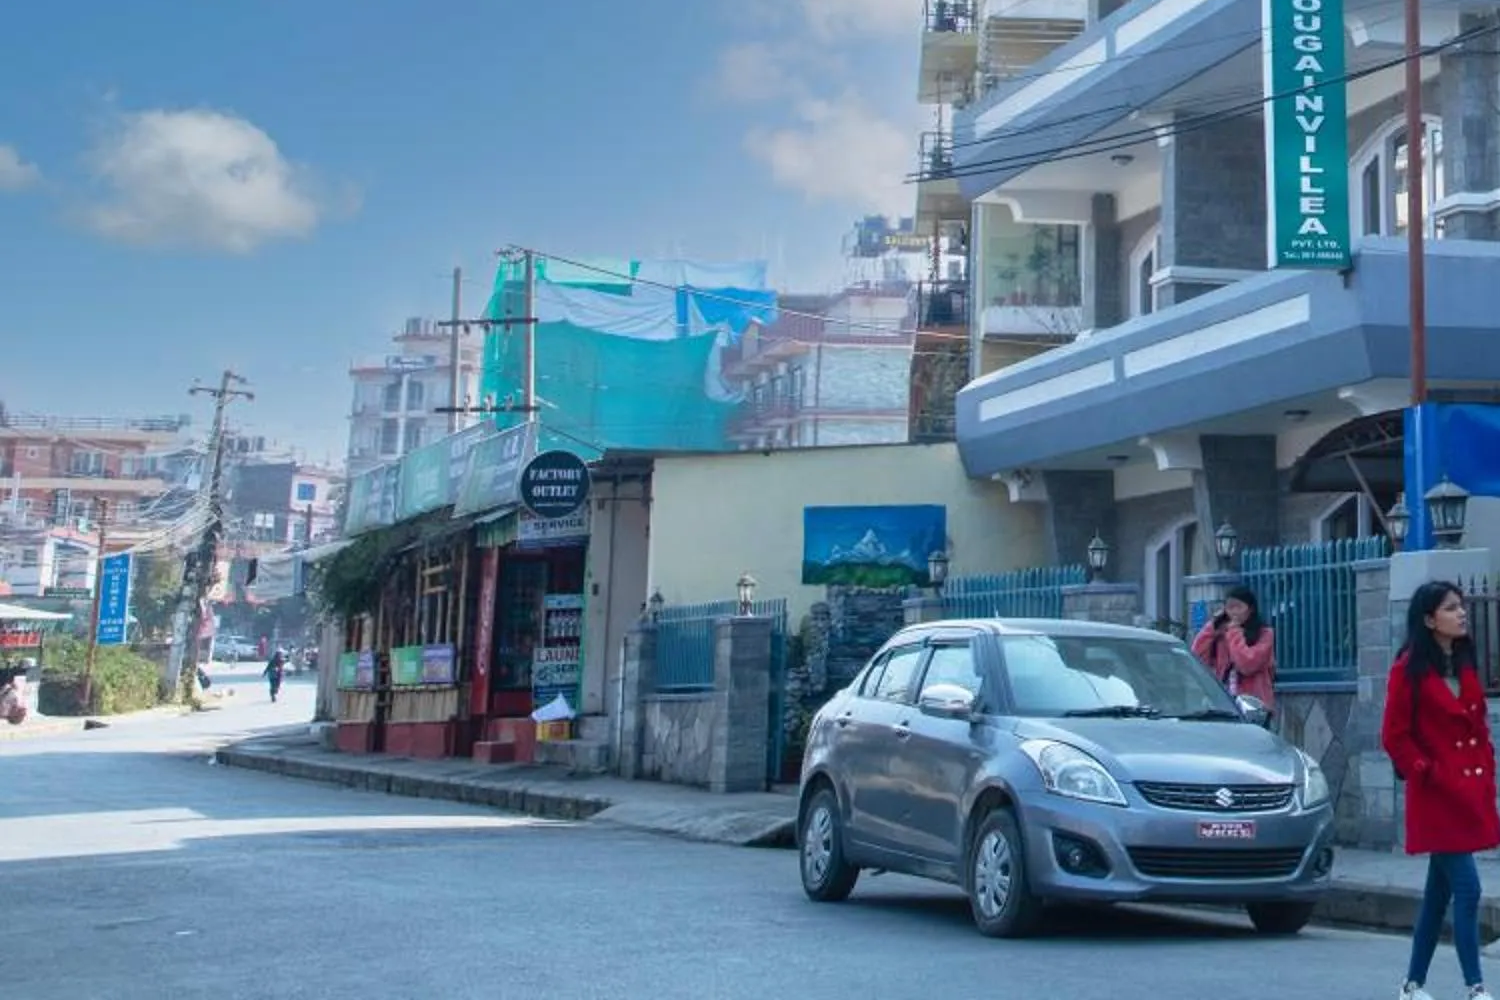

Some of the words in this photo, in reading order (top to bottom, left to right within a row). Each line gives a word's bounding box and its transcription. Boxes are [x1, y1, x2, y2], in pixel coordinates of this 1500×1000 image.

[529, 467, 583, 481] FACTORY
[531, 485, 579, 497] OUTLET
[533, 519, 586, 530] SERVICE
